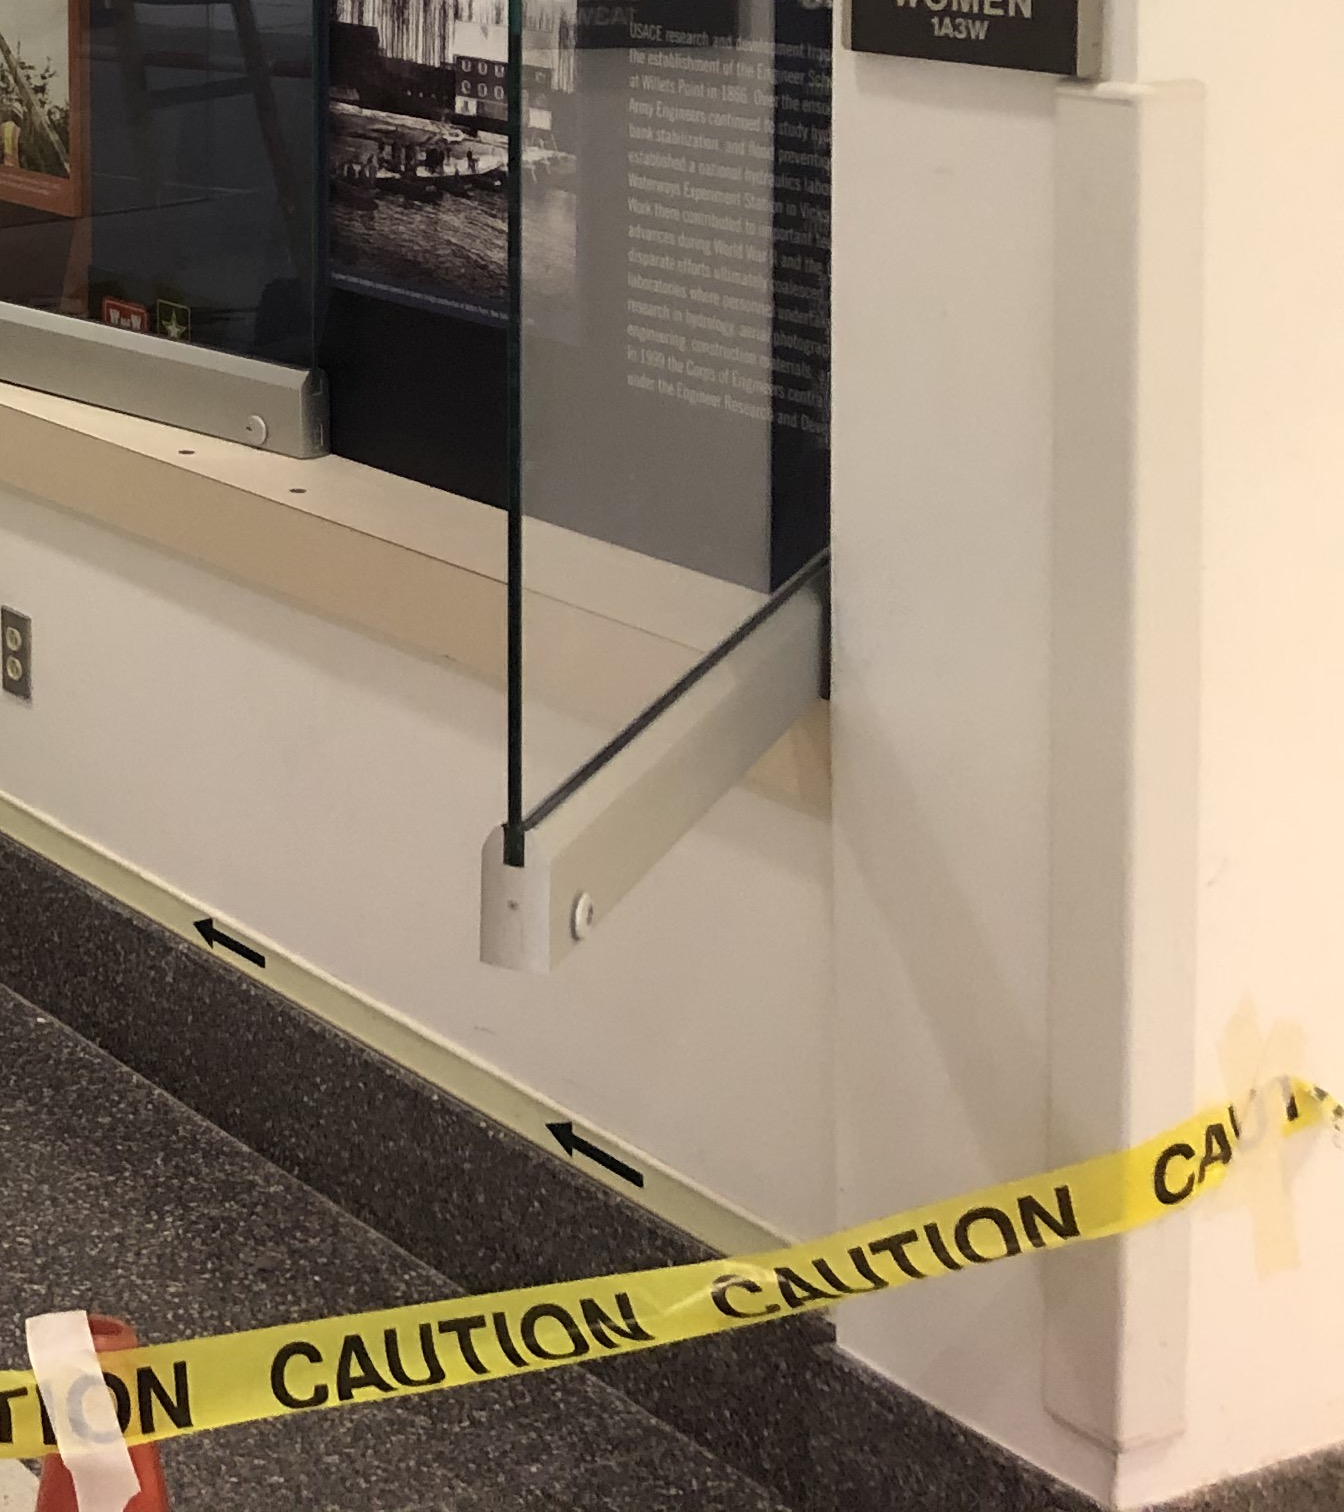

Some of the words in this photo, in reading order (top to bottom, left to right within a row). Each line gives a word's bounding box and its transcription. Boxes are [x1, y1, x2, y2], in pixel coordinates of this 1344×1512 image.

[630, 22, 661, 42] USACE
[666, 29, 709, 47] research
[931, 17, 989, 41] 1A3W
[629, 98, 655, 118] Army
[656, 101, 705, 123] Engineers
[710, 1185, 1081, 1320] CAUTION
[270, 1291, 655, 1410] CAUTION
